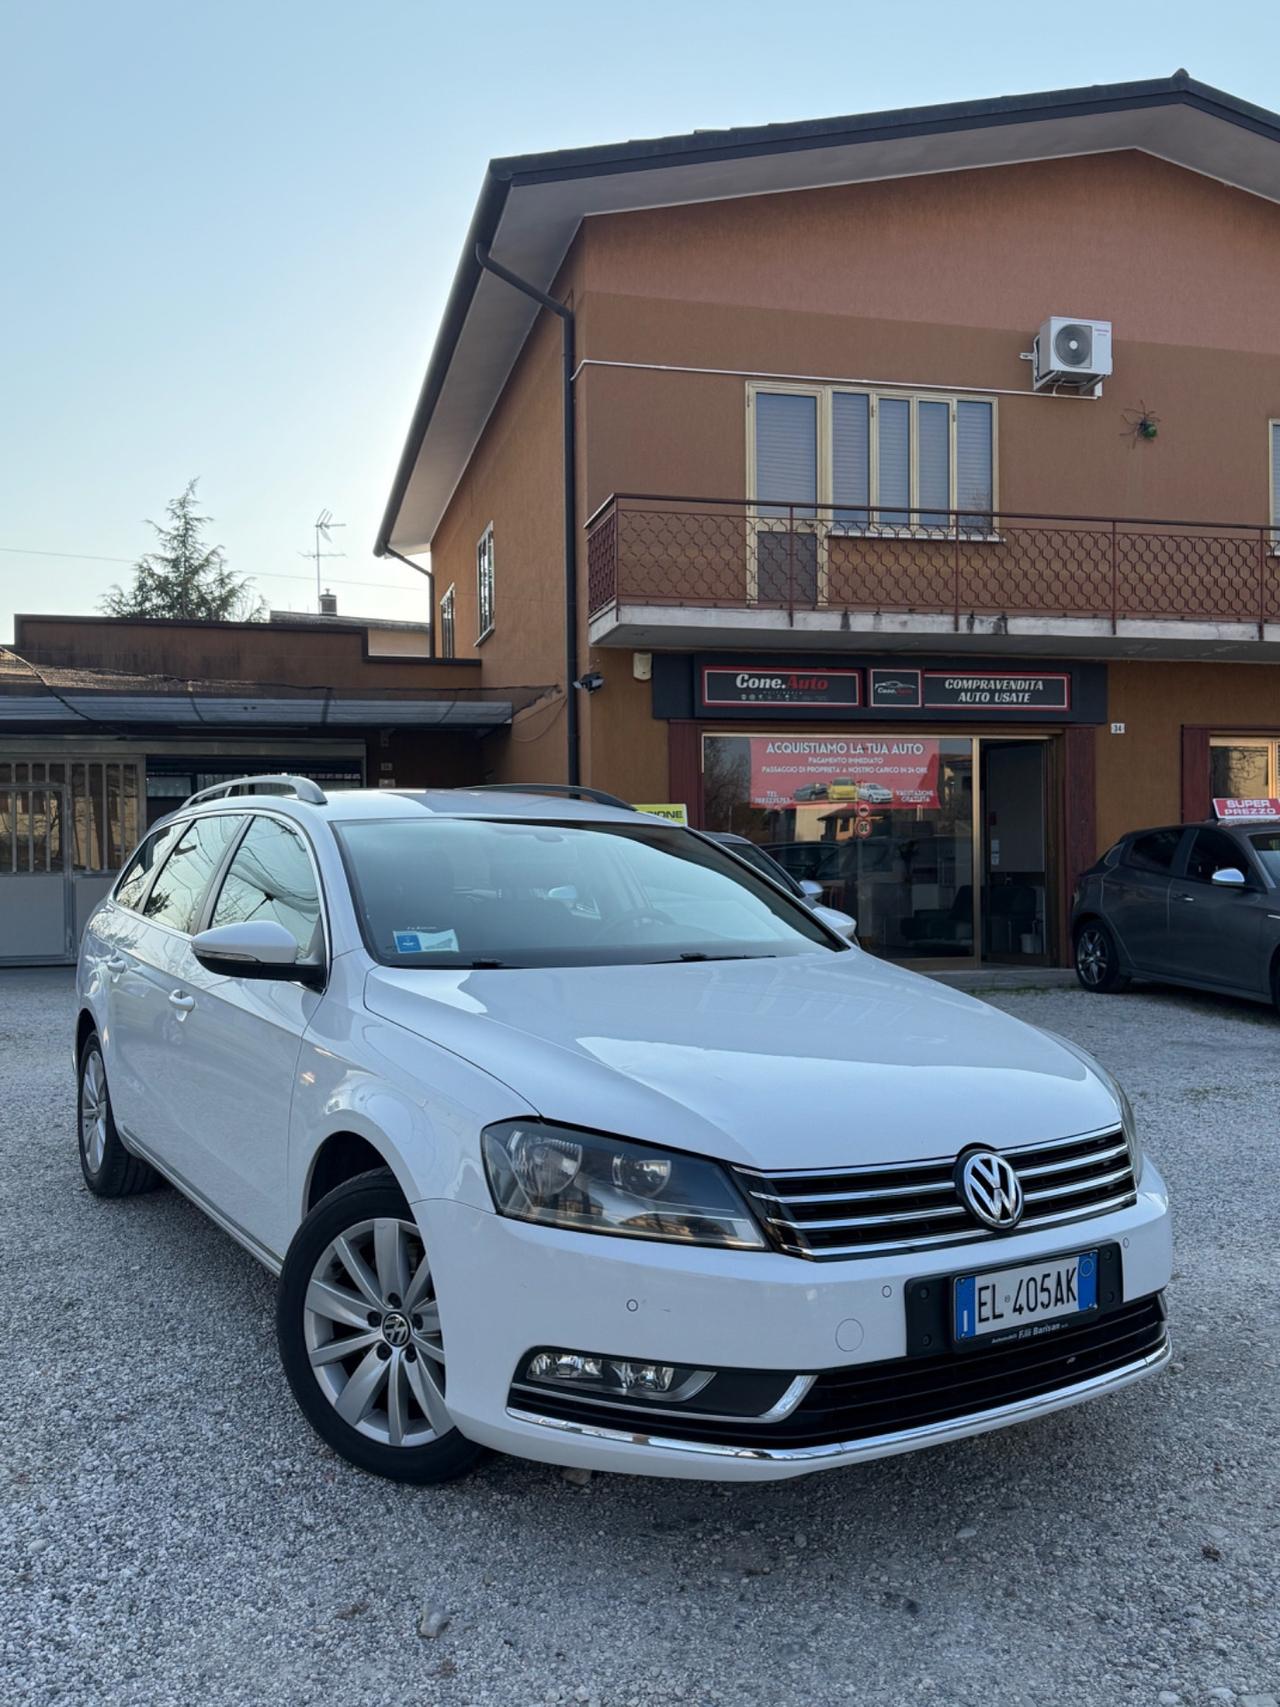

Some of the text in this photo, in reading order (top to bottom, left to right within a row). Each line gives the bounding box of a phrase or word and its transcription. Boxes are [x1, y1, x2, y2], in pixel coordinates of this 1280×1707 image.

[735, 673, 829, 690] Cone.Auto
[945, 678, 1044, 691] COMPRAVENDITA
[957, 691, 1032, 704] AUTO USATE
[766, 742, 925, 756] ACQUISTIAMO LA TUA AUTO
[807, 756, 848, 764] PAGAMENTO
[761, 765, 798, 773] PASSAGGIO
[848, 766, 875, 774] NOSTRO
[875, 766, 900, 774] CARICO
[1226, 799, 1271, 808] SUPER
[1224, 807, 1276, 815] PREZZO
[977, 1267, 1077, 1323] EL 405AK
